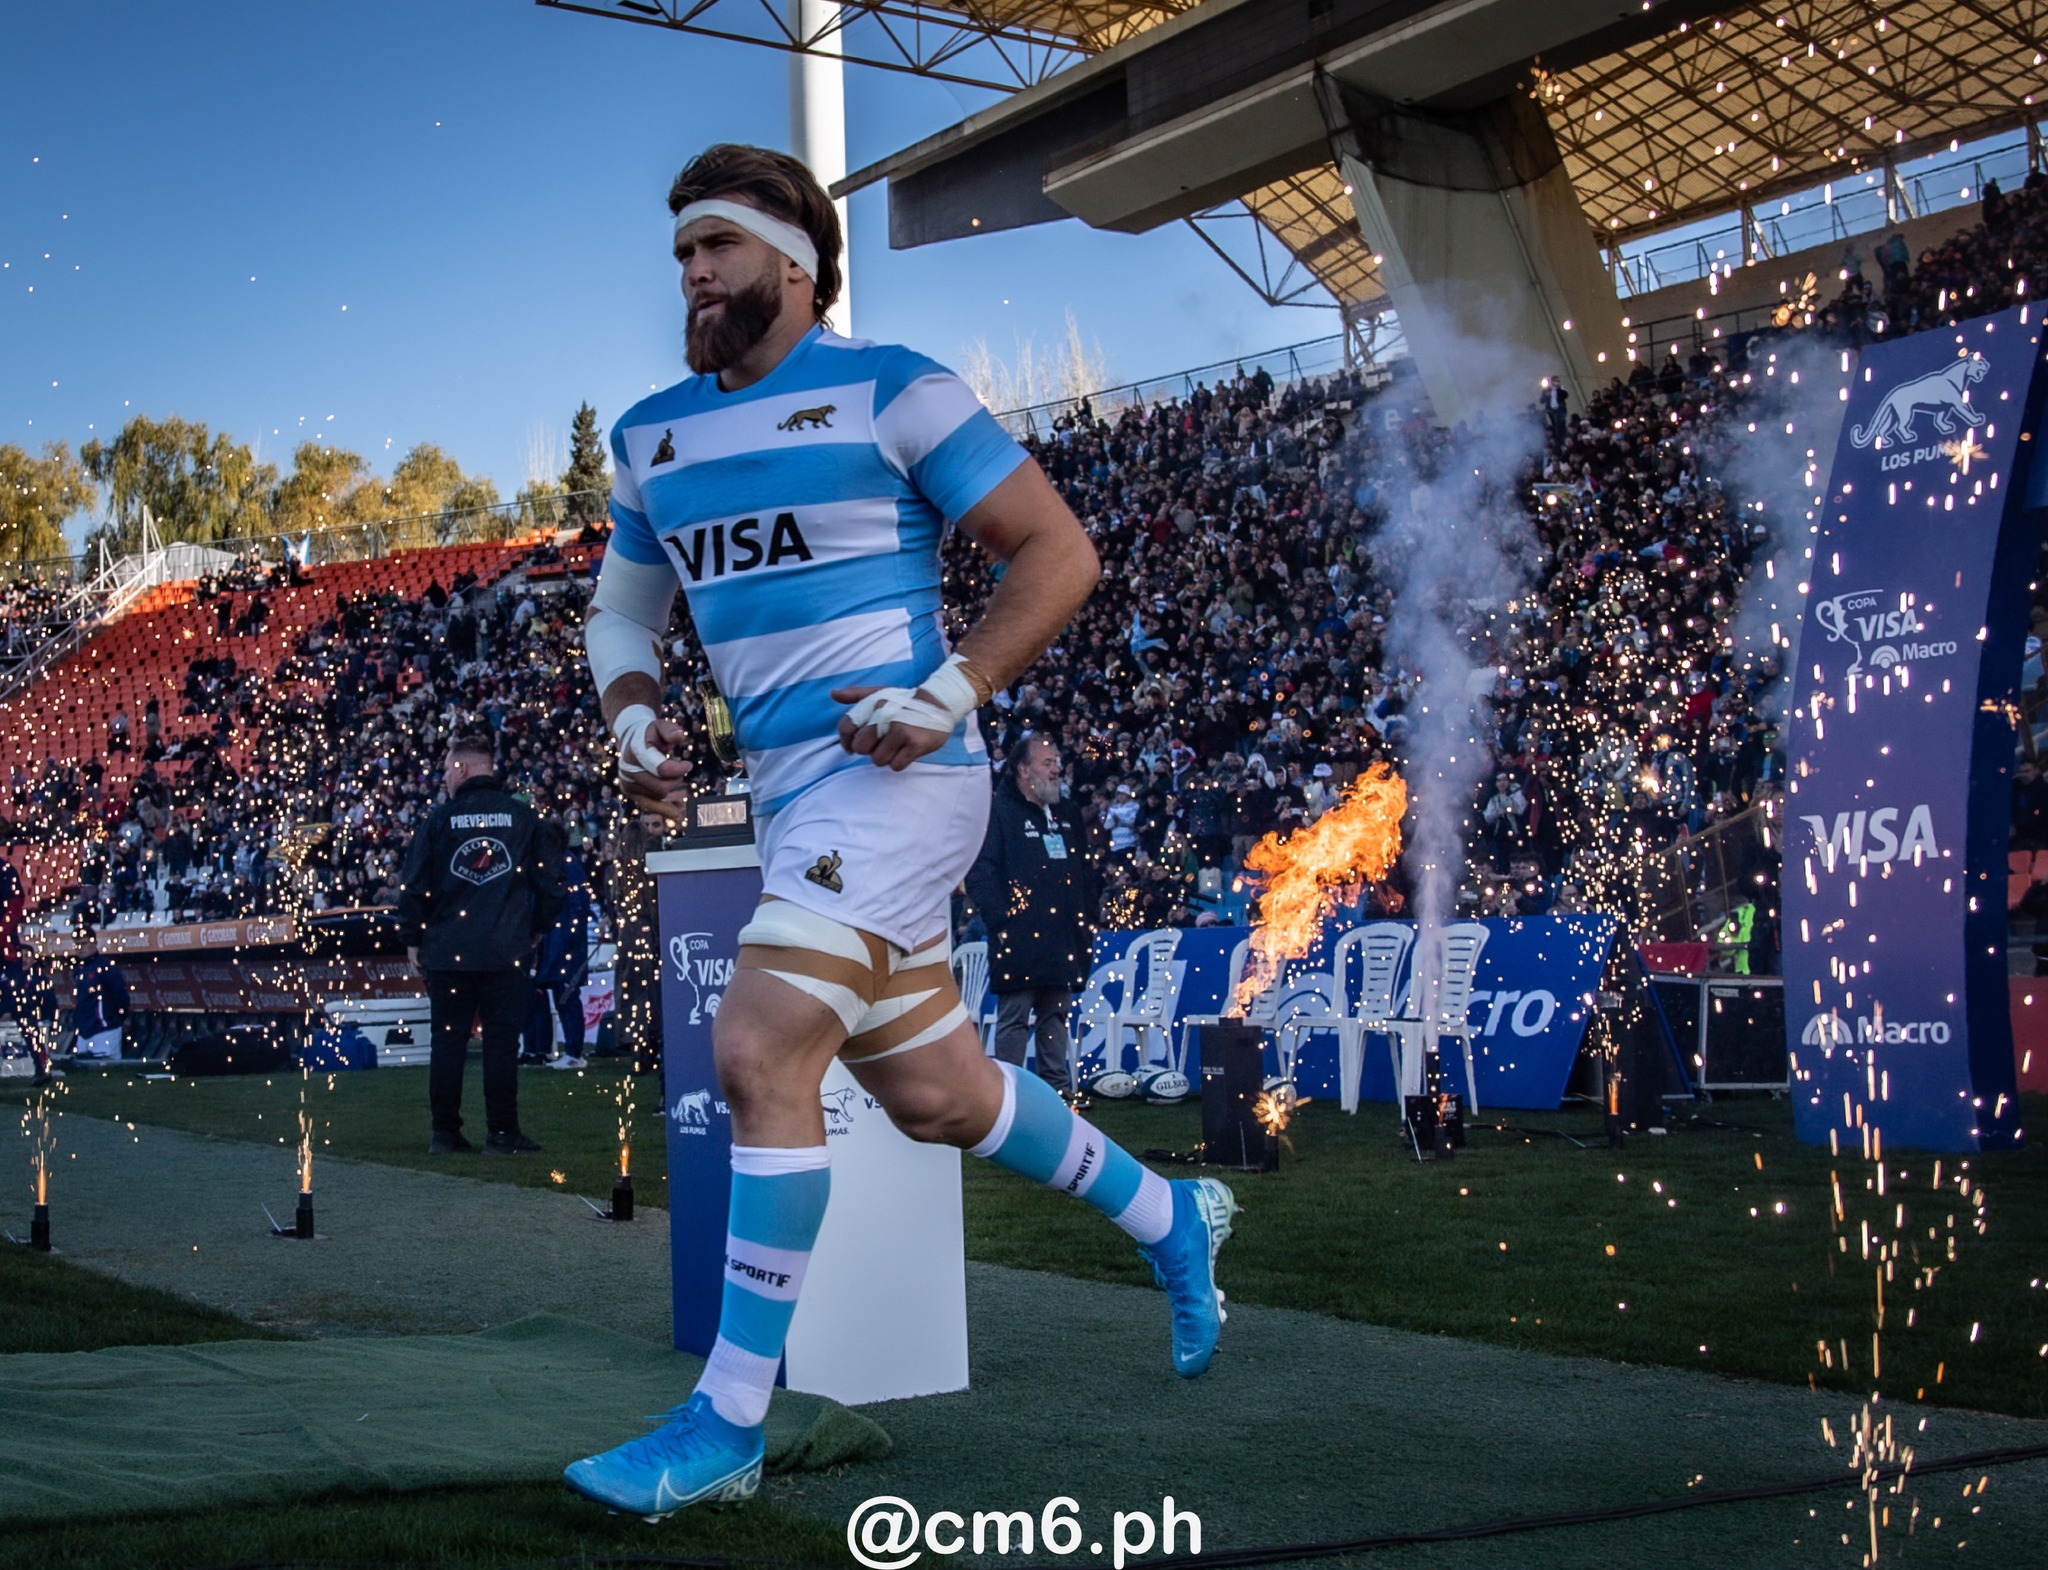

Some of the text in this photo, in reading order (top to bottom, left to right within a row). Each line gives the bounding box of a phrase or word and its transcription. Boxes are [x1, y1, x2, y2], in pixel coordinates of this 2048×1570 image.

[1881, 452, 1911, 472] LOS
[664, 512, 814, 582] VISA
[1847, 597, 1877, 610] COPA
[1853, 608, 1920, 642] VISA
[1902, 641, 1958, 661] Macro
[1799, 804, 1939, 867] VISA
[461, 840, 501, 856] ROD
[689, 940, 709, 950] COPA
[693, 958, 736, 986] VISA
[1857, 1016, 1951, 1045] Macro
[825, 1127, 849, 1137] UMAS
[731, 1259, 791, 1288] SPORTIF
